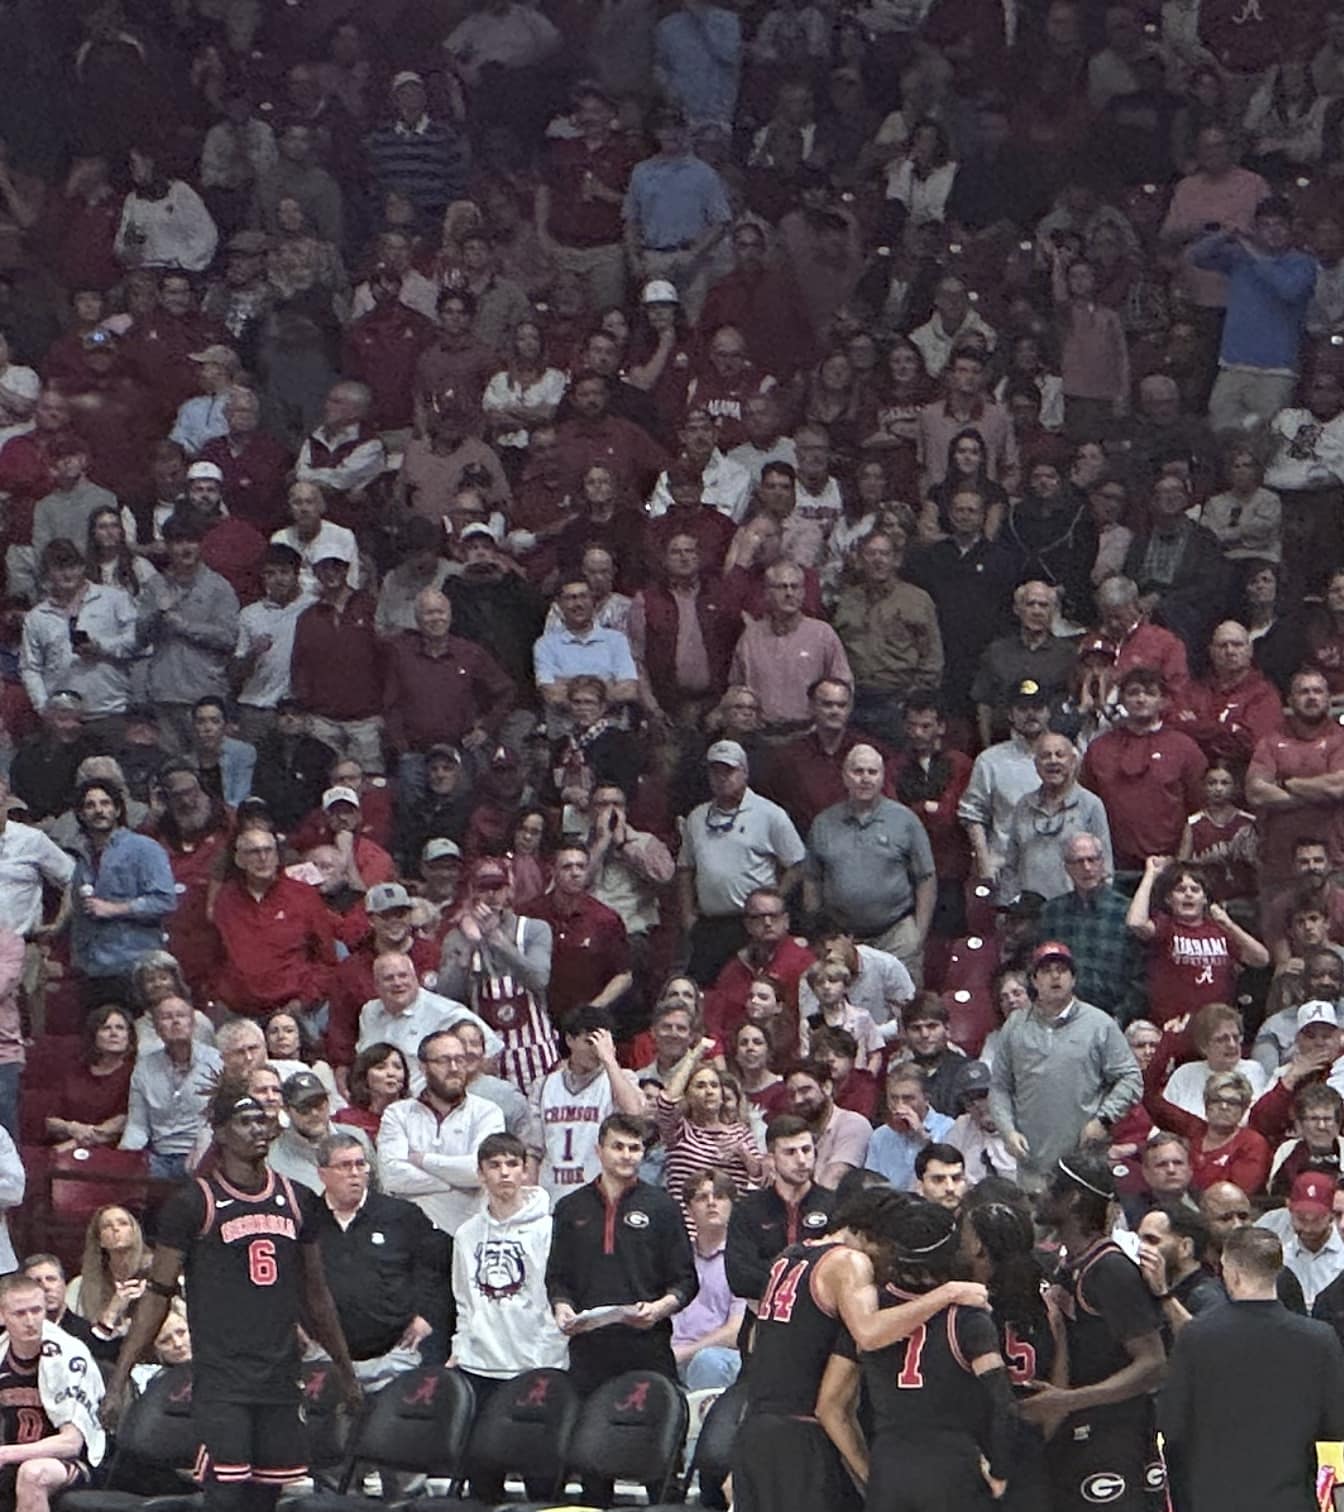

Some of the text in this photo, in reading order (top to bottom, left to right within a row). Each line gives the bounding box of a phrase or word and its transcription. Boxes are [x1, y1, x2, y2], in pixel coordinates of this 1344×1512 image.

[563, 1128, 573, 1161] 1
[248, 1239, 278, 1286] 6
[757, 1257, 808, 1323] 14
